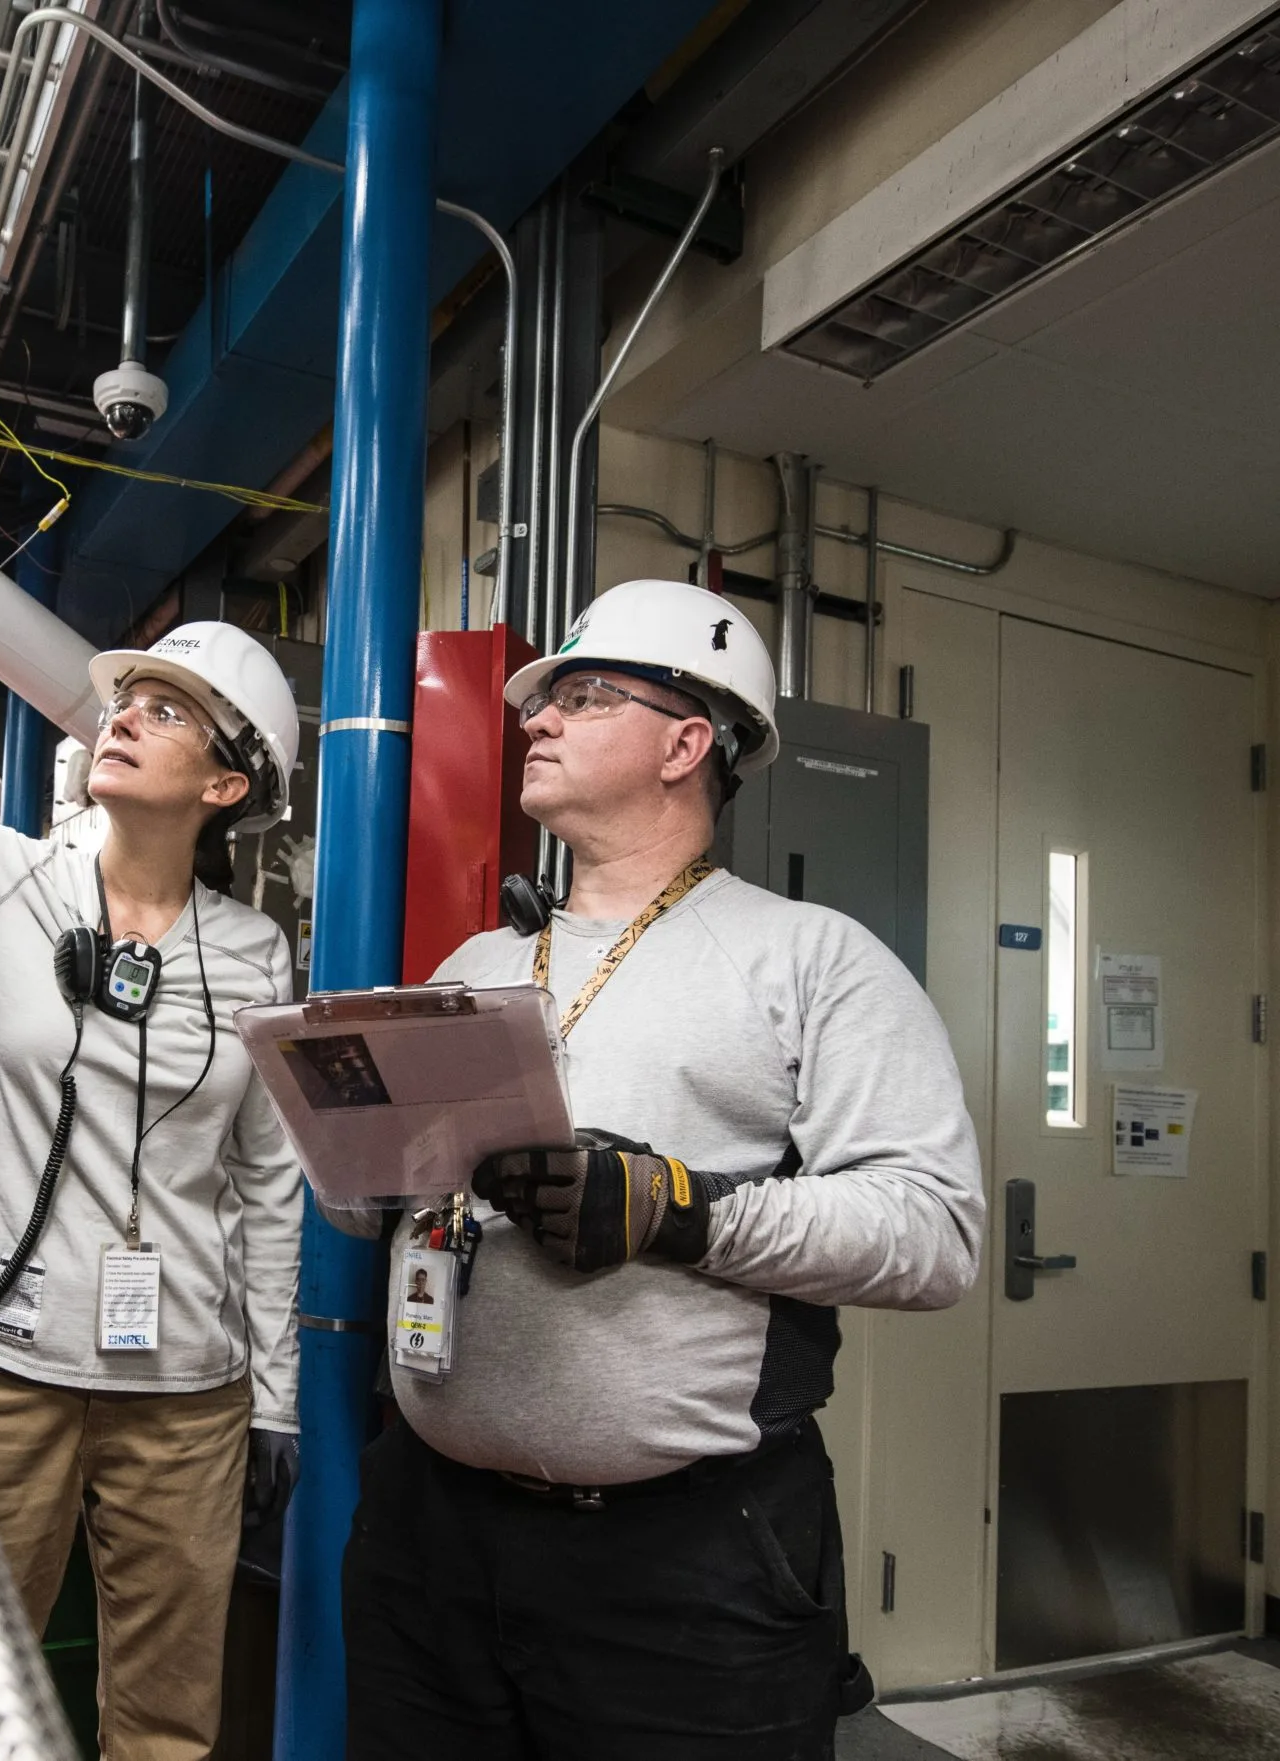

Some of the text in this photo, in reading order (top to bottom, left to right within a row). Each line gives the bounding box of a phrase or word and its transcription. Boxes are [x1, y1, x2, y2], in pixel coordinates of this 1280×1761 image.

[168, 639, 200, 648] NREL
[1014, 932, 1028, 942] 127
[118, 1334, 149, 1345] NREL
